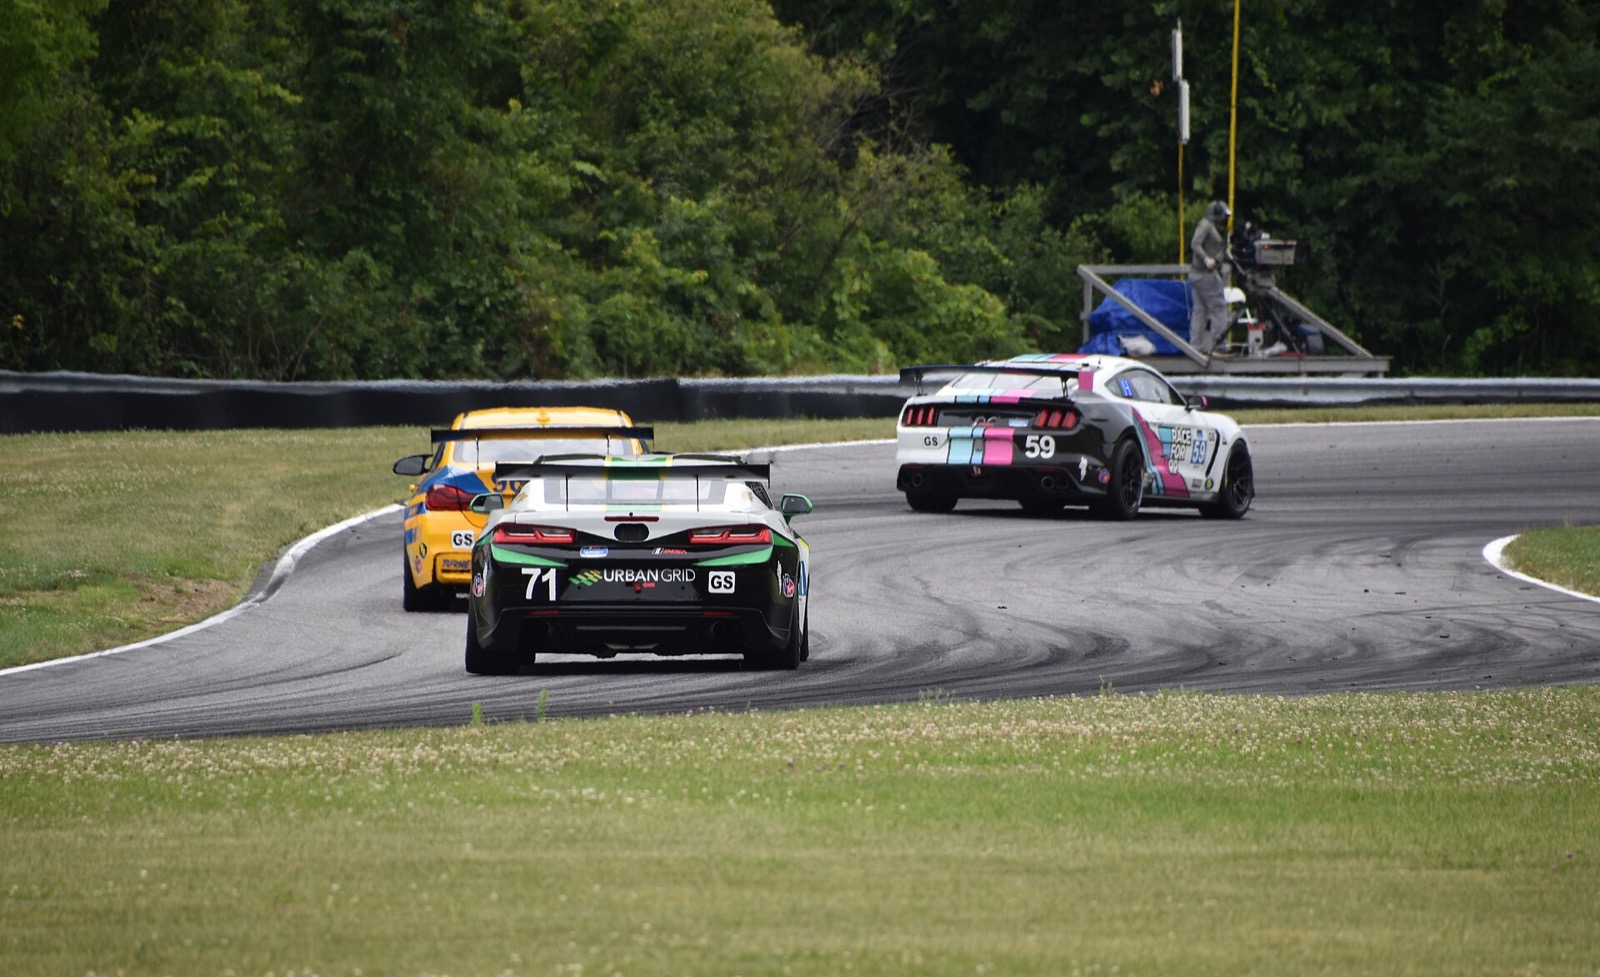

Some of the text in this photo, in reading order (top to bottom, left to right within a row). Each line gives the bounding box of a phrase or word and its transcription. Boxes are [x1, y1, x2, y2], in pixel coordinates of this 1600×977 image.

[924, 436, 938, 446] GS
[1171, 427, 1191, 445] RACE
[1025, 434, 1056, 459] 59
[1170, 444, 1186, 460] FOR
[1192, 440, 1206, 463] 59
[453, 533, 473, 546] GS
[603, 568, 696, 582] URBAN GRID
[710, 575, 734, 589] GS
[521, 567, 557, 601] 71
